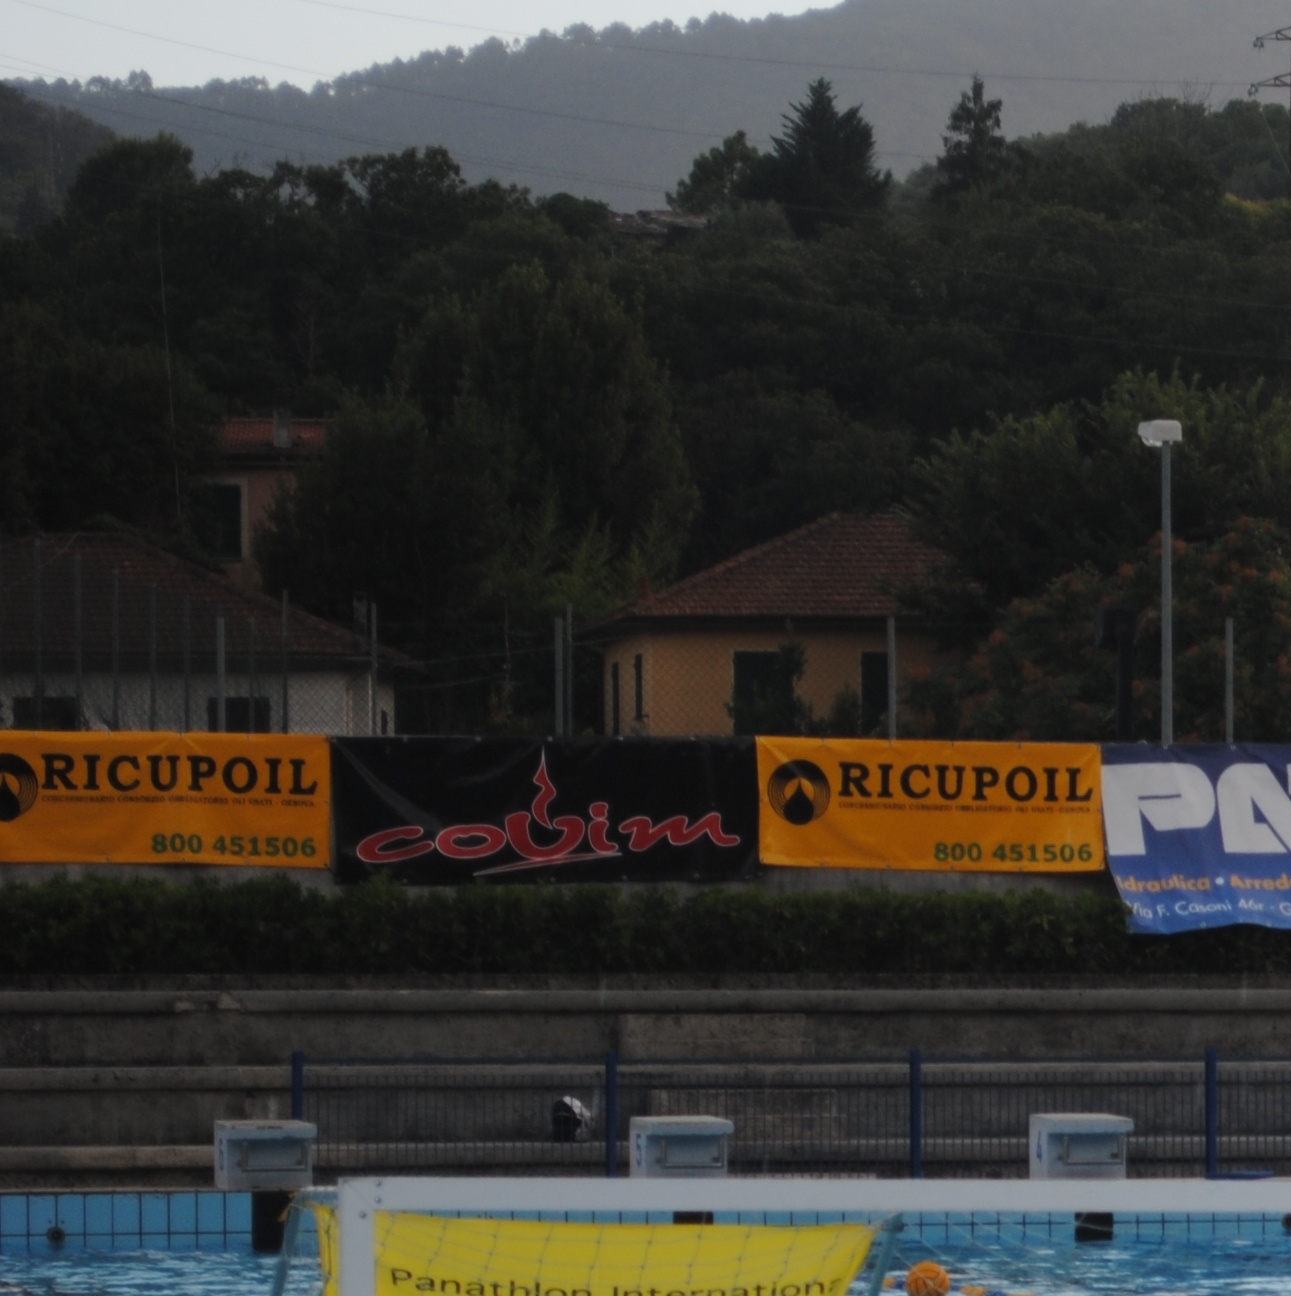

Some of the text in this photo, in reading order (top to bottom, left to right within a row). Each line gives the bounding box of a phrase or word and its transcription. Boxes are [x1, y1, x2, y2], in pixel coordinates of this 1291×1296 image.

[41, 753, 319, 796] RICUPOIL
[838, 762, 1094, 803] RICUPOIL
[151, 834, 318, 858] 800 451506
[934, 842, 1093, 864] 800 451506
[1115, 874, 1211, 893] Idraulica
[1156, 903, 1170, 918] F.
[1175, 900, 1233, 916] Casoni
